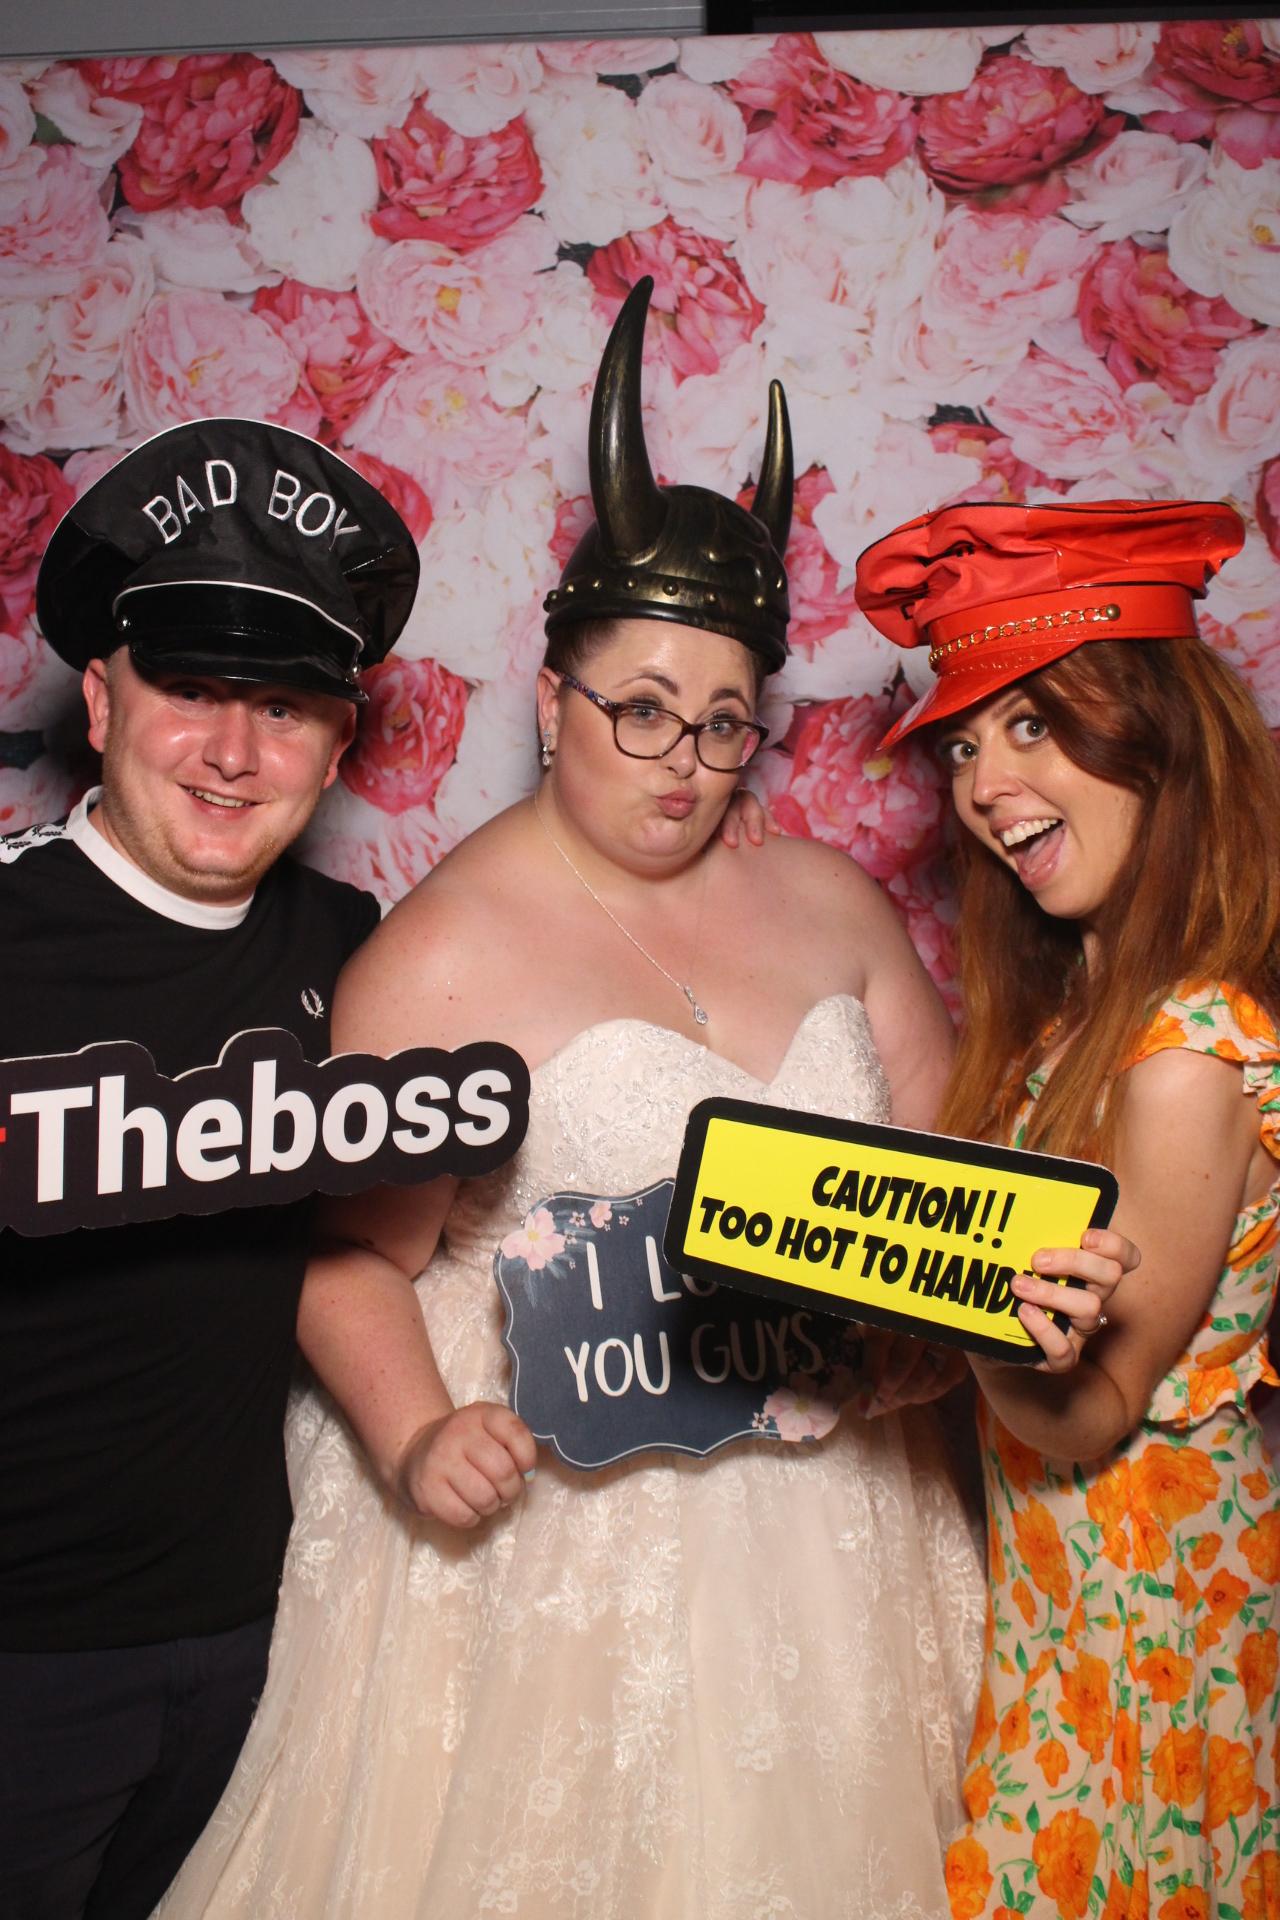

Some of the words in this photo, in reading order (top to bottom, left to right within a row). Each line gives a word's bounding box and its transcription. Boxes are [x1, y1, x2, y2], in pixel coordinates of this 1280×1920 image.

[142, 459, 238, 545] BAD
[267, 469, 362, 551] BOY
[0, 1058, 512, 1203] Theboss
[811, 1165, 1016, 1248] CAUTION!!
[586, 1241, 603, 1310] I
[699, 1196, 773, 1247] TOO
[775, 1216, 858, 1270] HOT
[860, 1235, 910, 1284] TO
[909, 1249, 1058, 1320] HAND
[564, 1331, 671, 1402] YOU
[690, 1311, 825, 1384] GUYS
